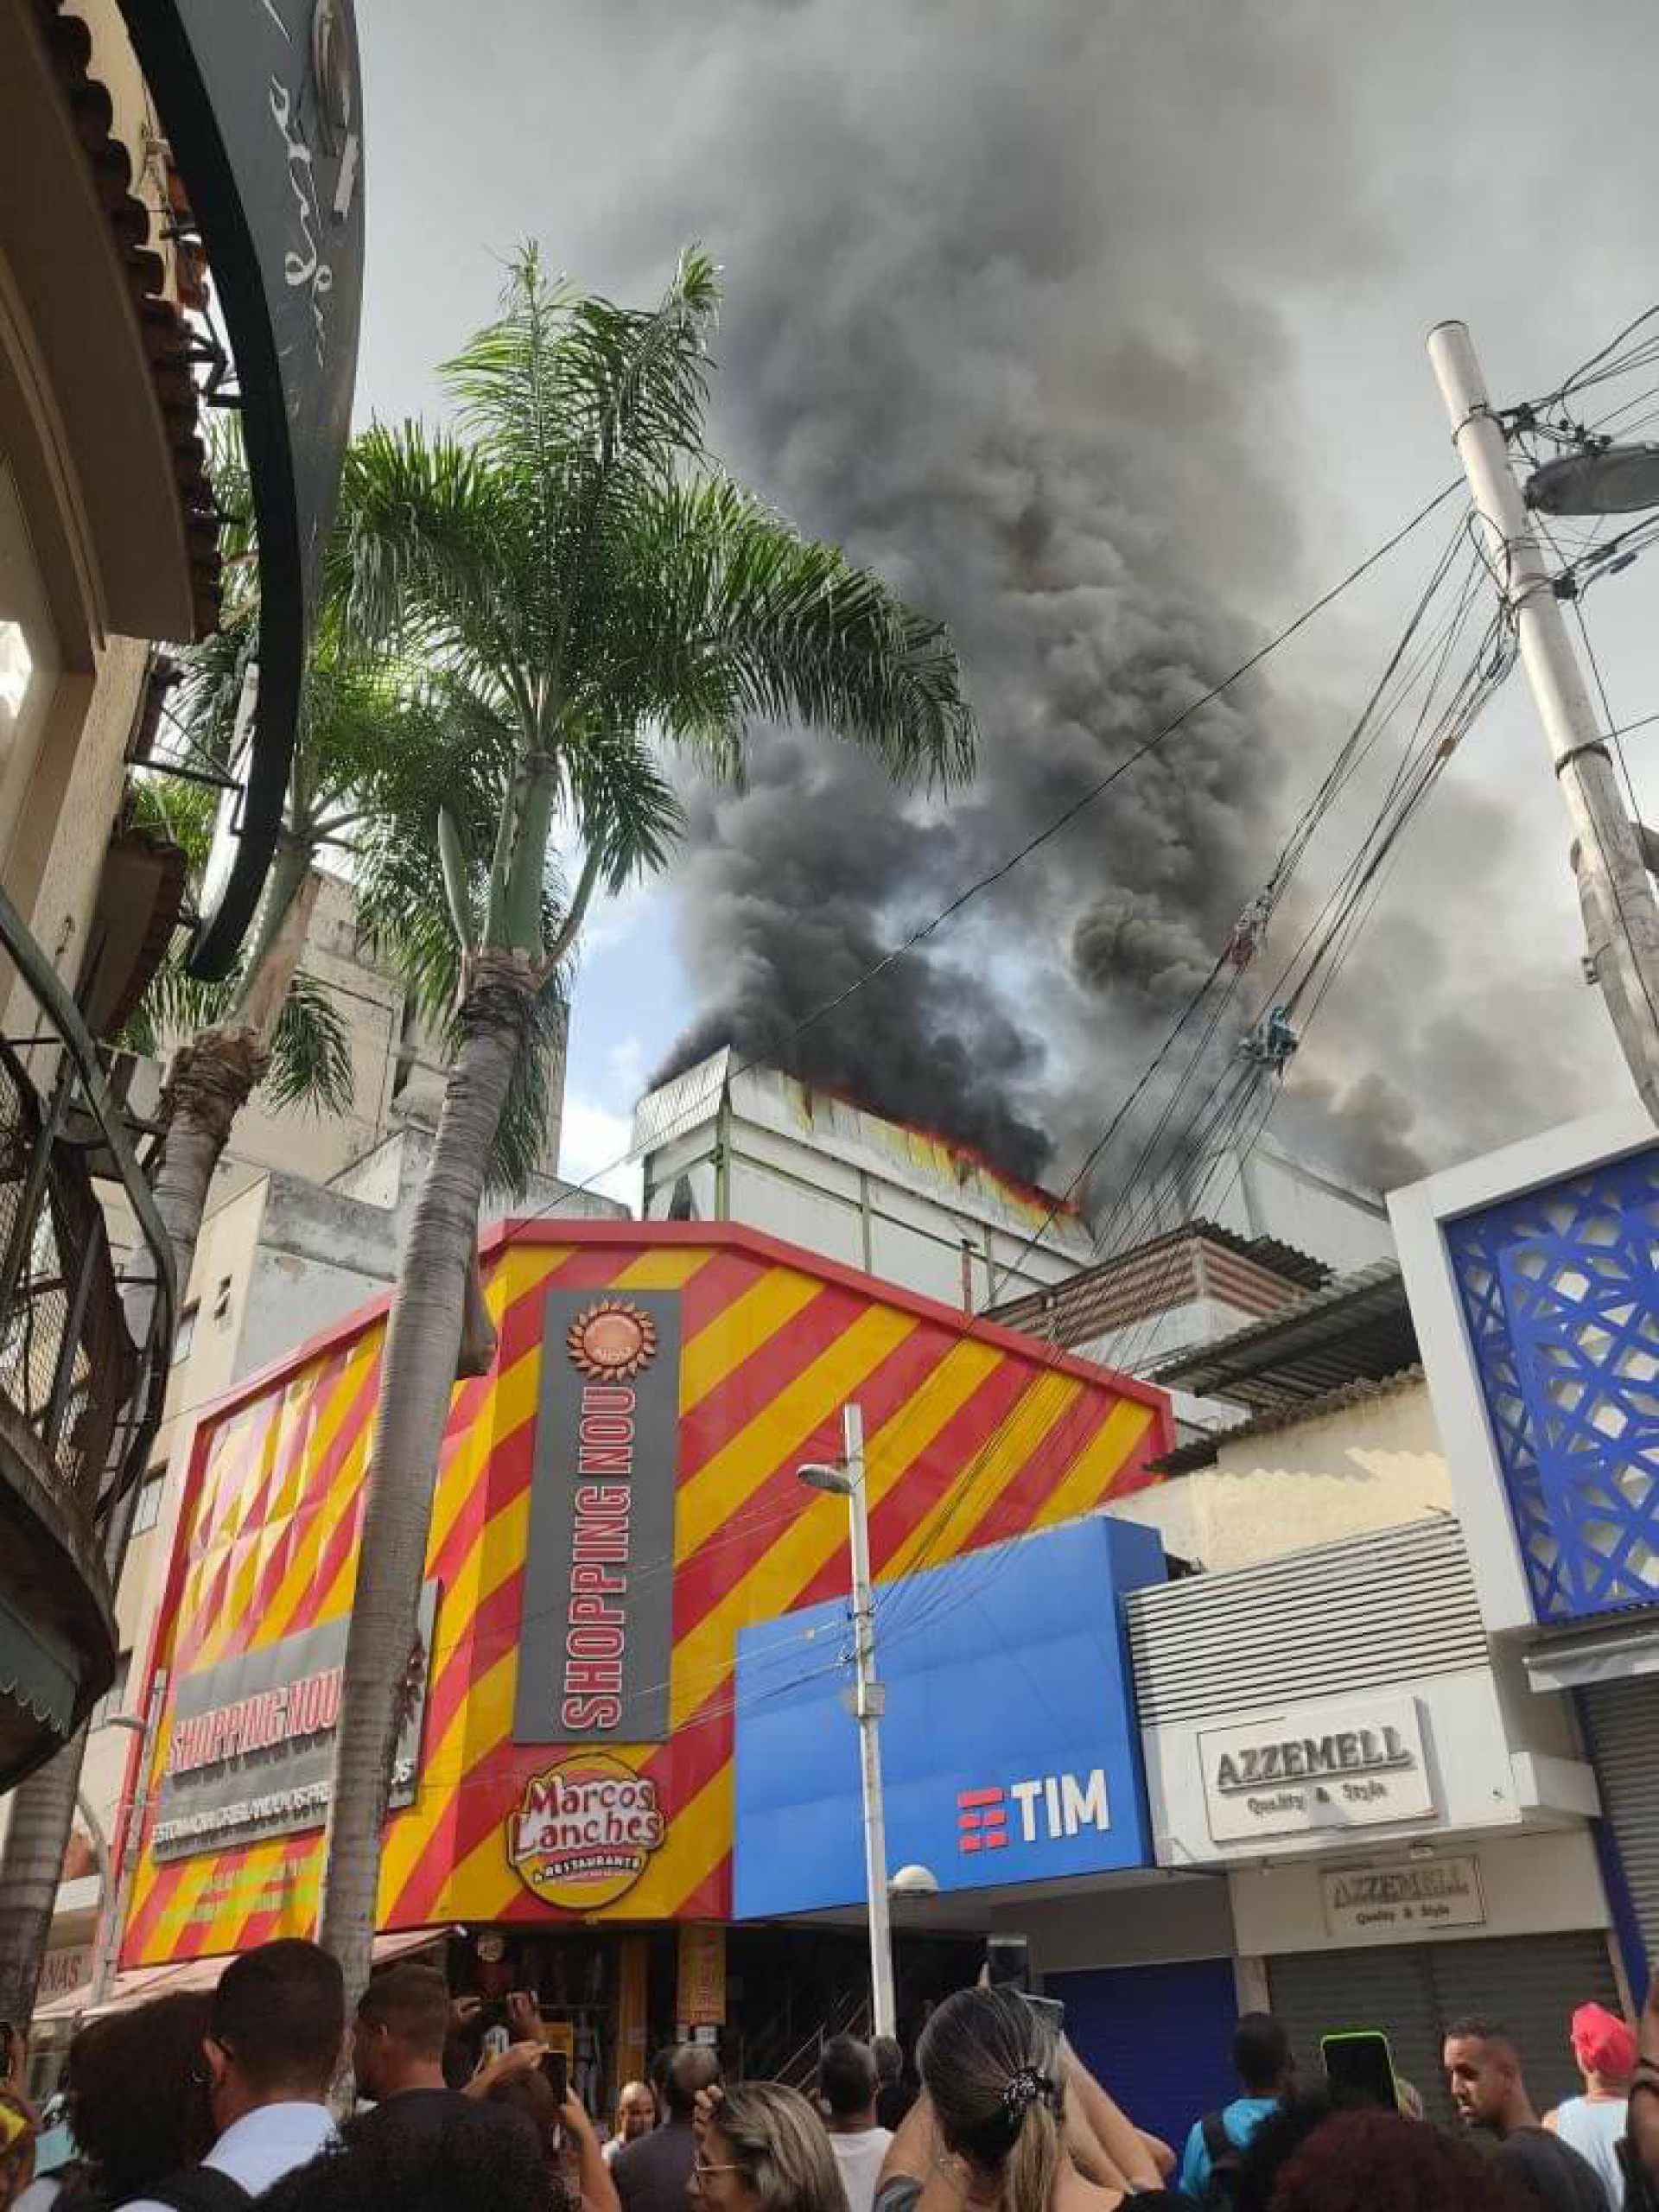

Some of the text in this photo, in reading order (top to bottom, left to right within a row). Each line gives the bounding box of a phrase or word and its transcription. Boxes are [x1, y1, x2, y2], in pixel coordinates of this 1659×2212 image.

[578, 1386, 637, 1474] NOU
[562, 1485, 632, 1730] SHOPPING
[1217, 1726, 1414, 1787] AZZEMELL
[530, 1777, 655, 1817] Marcos
[1009, 1768, 1110, 1842] TIM
[1247, 1792, 1306, 1815] Quality
[1341, 1778, 1388, 1803] Style
[510, 1810, 662, 1854] Lanches
[1333, 1865, 1469, 1909] AZZEMELL
